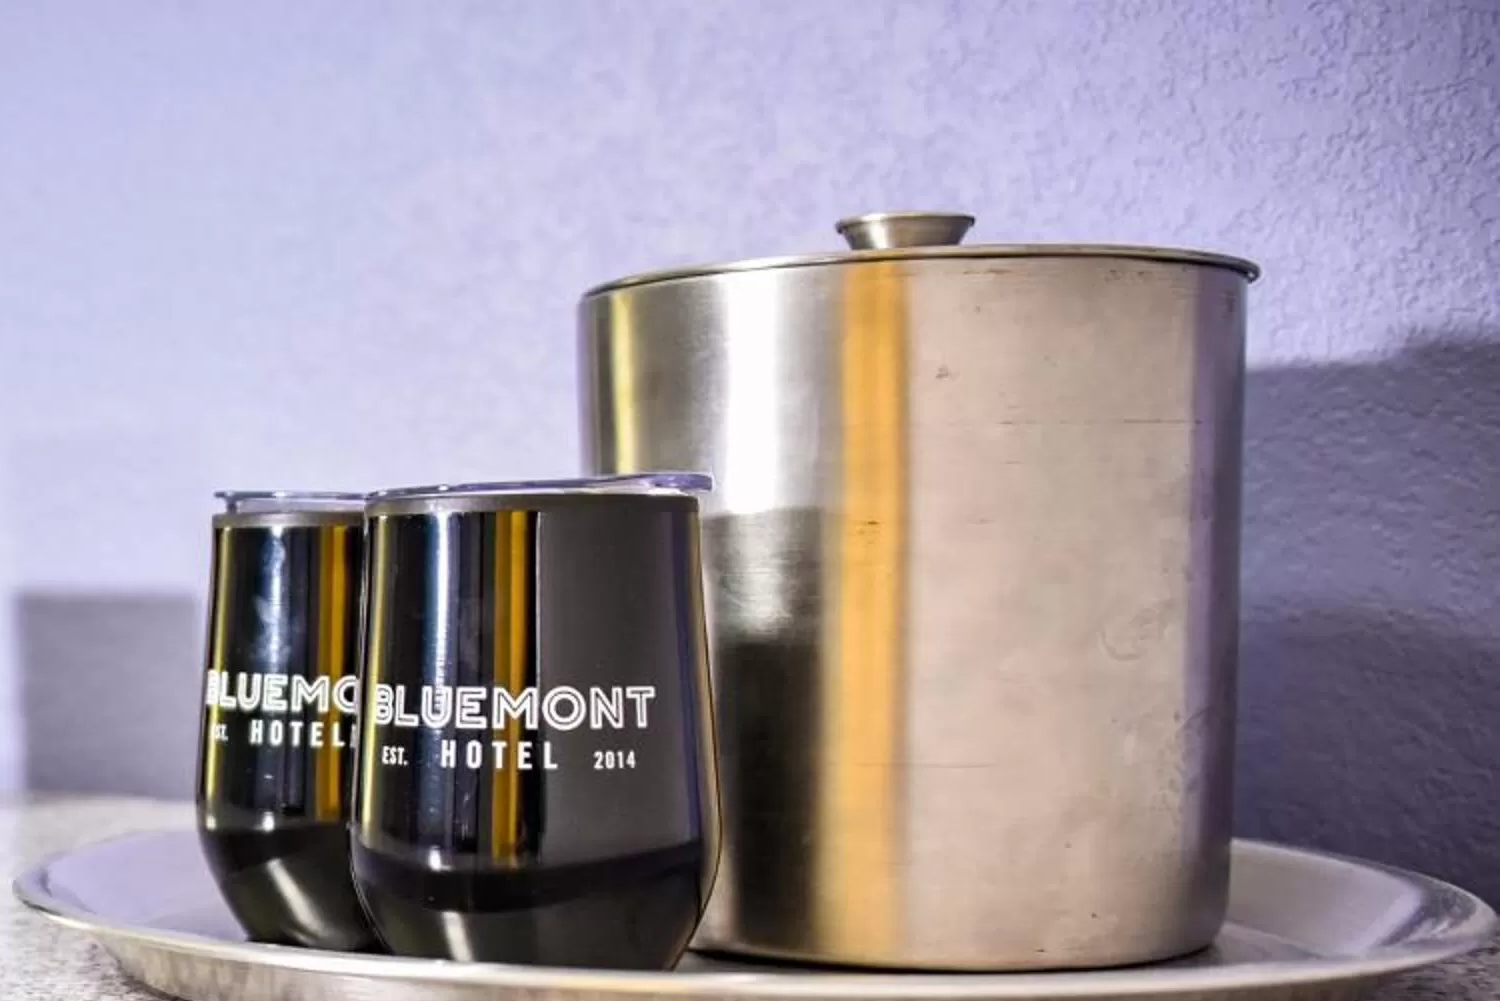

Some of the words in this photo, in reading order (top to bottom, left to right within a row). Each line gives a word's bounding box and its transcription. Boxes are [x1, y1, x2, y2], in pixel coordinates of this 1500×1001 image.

[206, 669, 362, 713] BLUEMO
[374, 683, 656, 731] BLUEMONT
[250, 719, 345, 748] HOTEL
[381, 745, 408, 766] EST.
[439, 739, 558, 770] HOTEL
[593, 750, 636, 769] 2014
